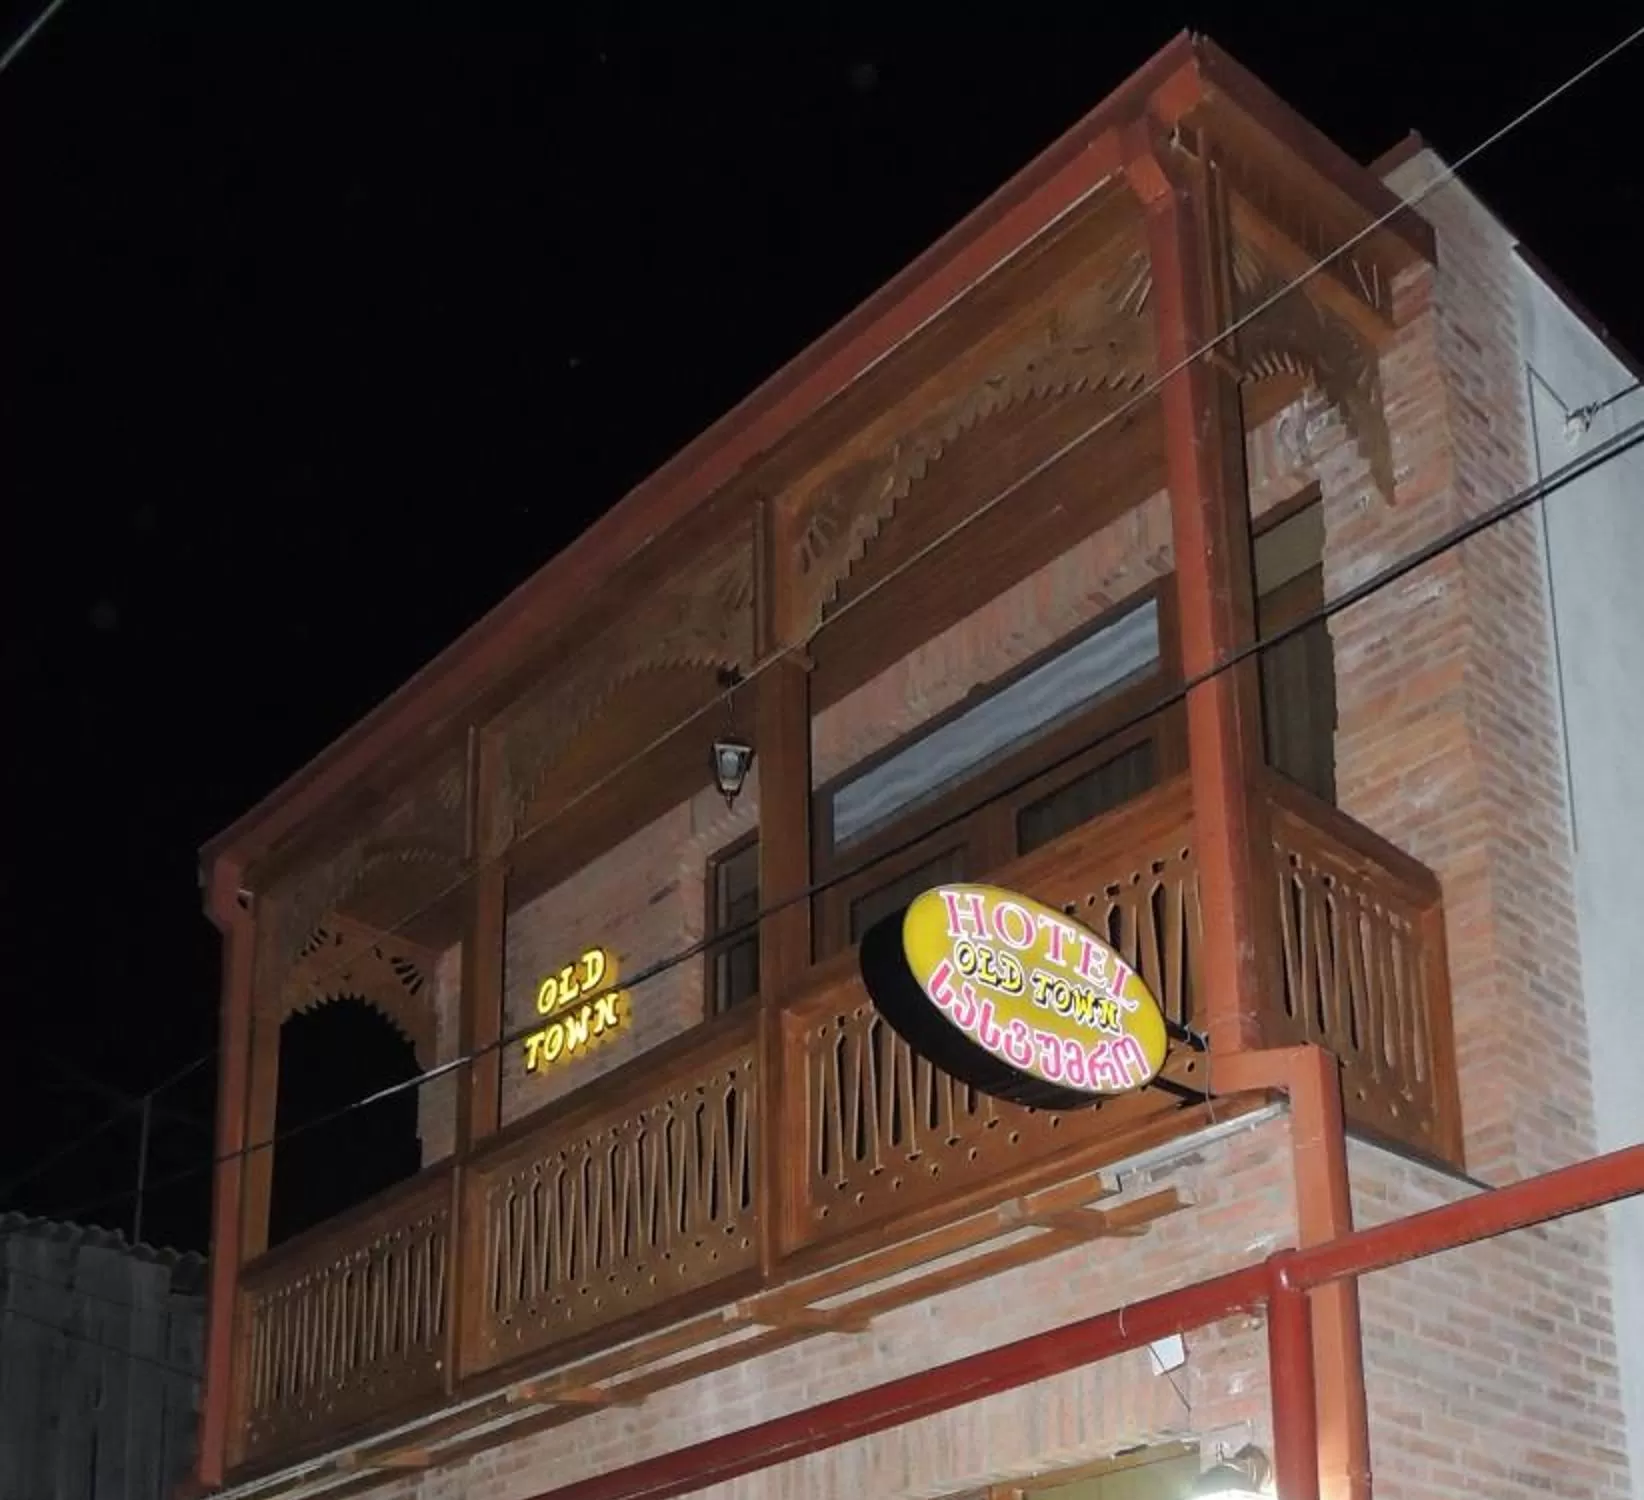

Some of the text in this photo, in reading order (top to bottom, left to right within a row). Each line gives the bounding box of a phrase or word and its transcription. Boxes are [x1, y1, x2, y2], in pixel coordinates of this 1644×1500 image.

[537, 948, 606, 1015] OLD
[939, 890, 1139, 1010] HOTEL
[952, 939, 1123, 1035] OLD TOWN
[525, 993, 620, 1071] TOWN
[926, 960, 1152, 1090] სასტუმრო
